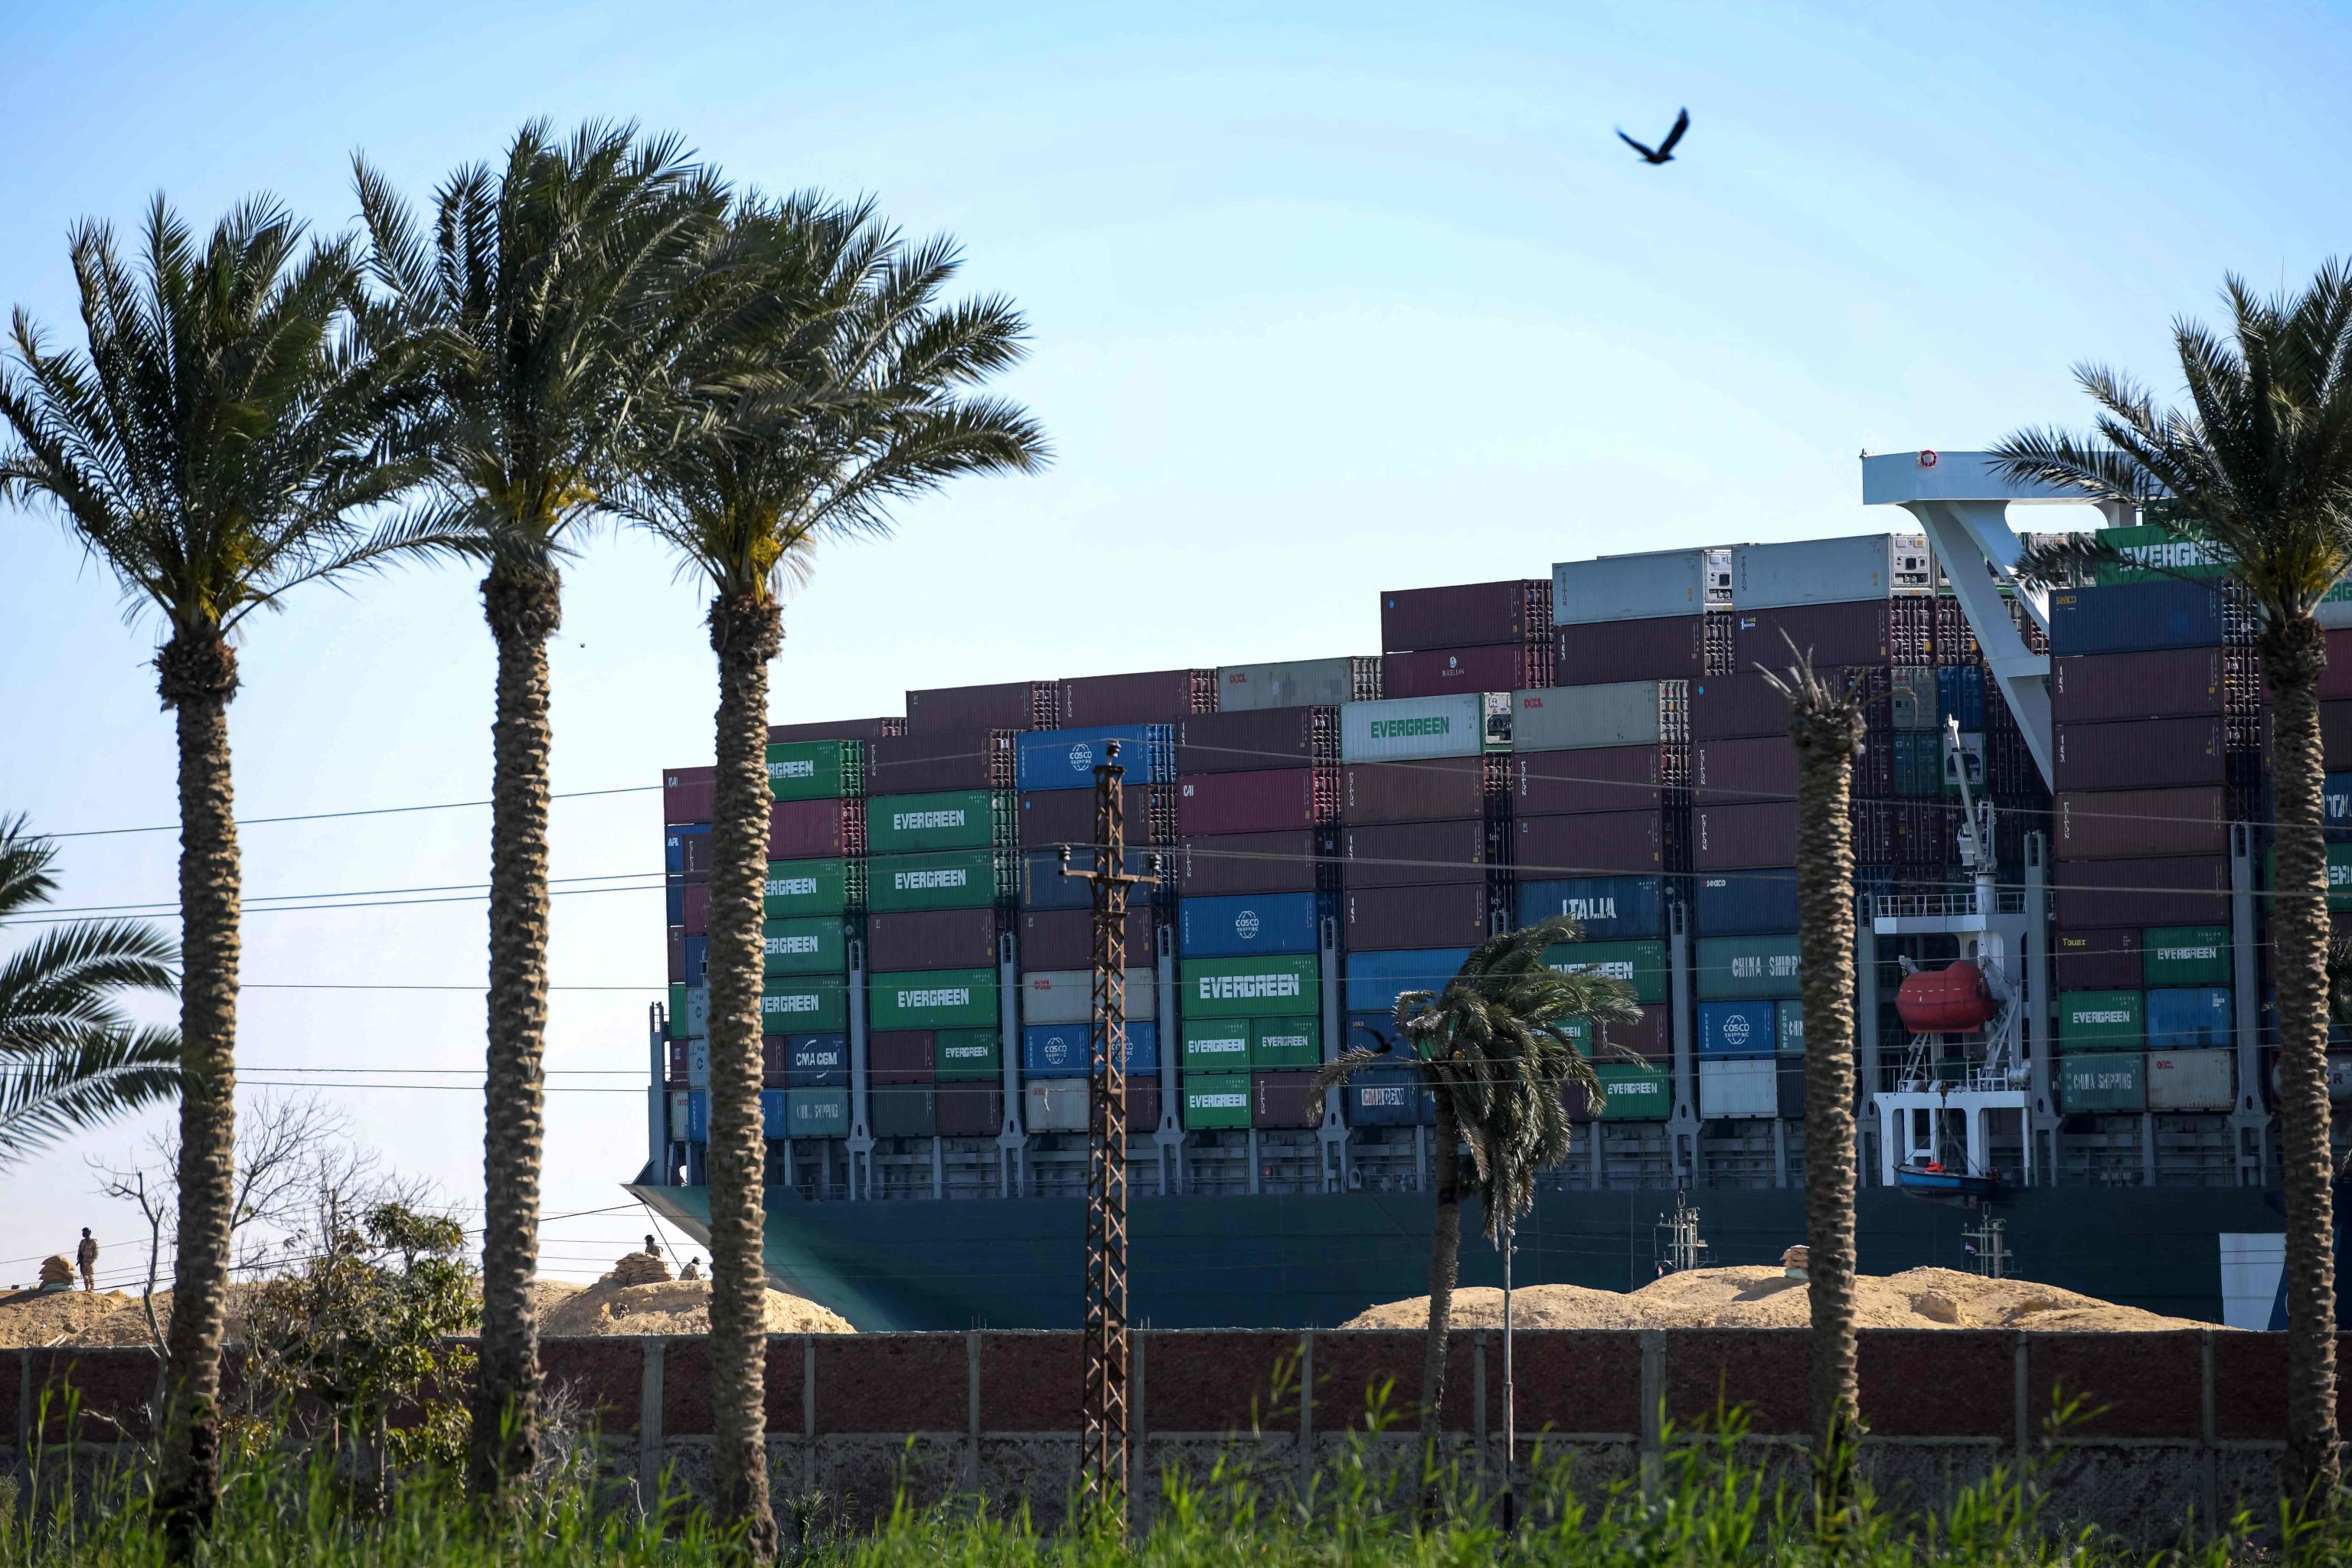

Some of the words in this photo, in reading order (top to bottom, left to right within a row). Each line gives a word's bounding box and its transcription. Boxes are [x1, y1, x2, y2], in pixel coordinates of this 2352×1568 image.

[1230, 674, 1246, 684] OOCL
[1524, 697, 1544, 708] OOCL
[1371, 717, 1449, 739] EVERGREEN
[1070, 751, 1093, 760] COSCO
[766, 760, 814, 779] RGREEN
[1183, 785, 1194, 796] CAI
[893, 809, 965, 830] EVERGREEN
[895, 869, 966, 890] EVERGREEN
[1707, 879, 1726, 887] seaco
[766, 878, 817, 897] ERGREEN
[1563, 897, 1616, 920] ITALIA
[1236, 918, 1259, 927] COSCO
[766, 936, 818, 954] ERGREEN
[2063, 938, 2087, 948] Touax
[2158, 946, 2216, 960] EVERGREEN
[1732, 957, 1761, 977] CHINA
[1769, 955, 1801, 976] SHIPP
[1200, 974, 1299, 999] EVERGREEN
[760, 994, 819, 1013] VERGREEN
[898, 988, 969, 1008] EVERGREEN
[2073, 1011, 2130, 1024] EVERGREEN
[1723, 1022, 1749, 1032] COSCO
[1044, 1044, 1067, 1053] COSCO
[1189, 1039, 1246, 1053] EVERGREEN
[1263, 1036, 1308, 1047] EVERGREEN
[796, 1053, 815, 1066] CMA
[817, 1051, 838, 1066] CGM
[946, 1047, 988, 1058] EVERGREEN
[2073, 1073, 2096, 1089] CHINA
[2099, 1072, 2132, 1089] SHIPPING
[1608, 1082, 1658, 1095] EVERGREEN
[1190, 1094, 1246, 1108] EVERGREEN
[814, 1103, 838, 1119] SHIPPING
